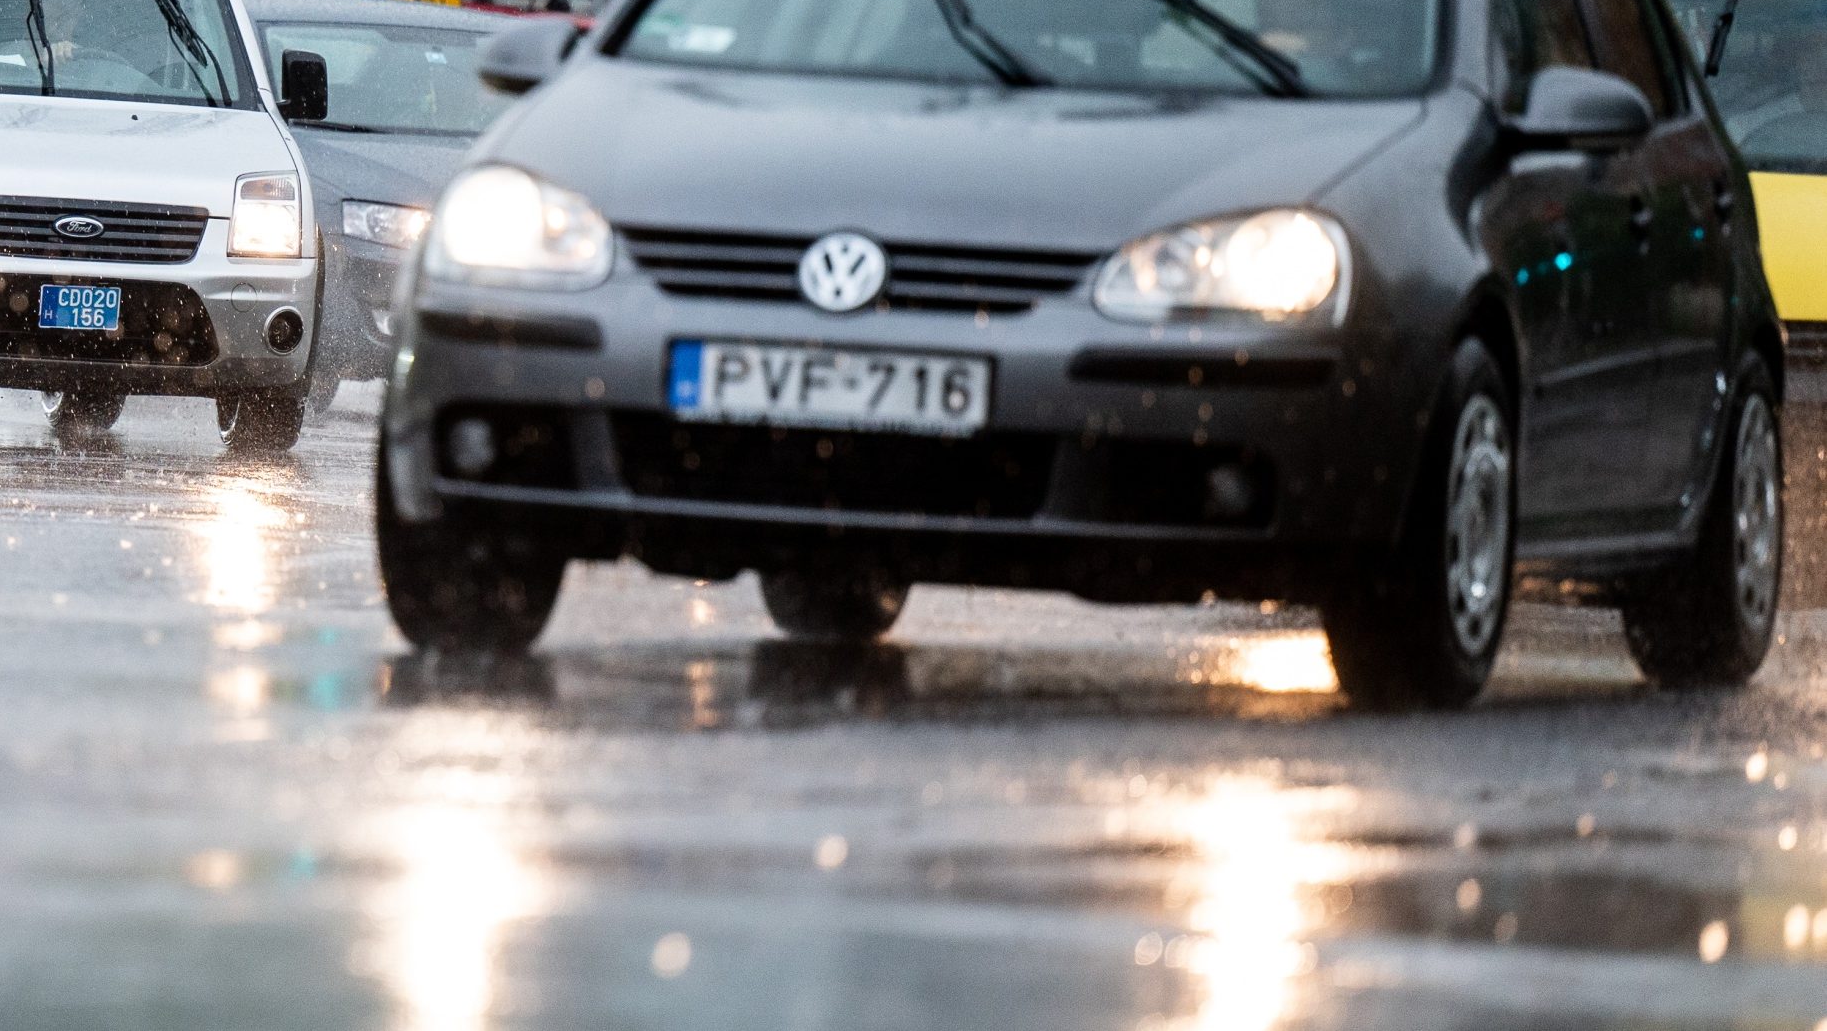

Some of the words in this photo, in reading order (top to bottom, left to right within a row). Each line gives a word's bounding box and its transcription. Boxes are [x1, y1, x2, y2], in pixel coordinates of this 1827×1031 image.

[58, 288, 118, 309] CD020
[72, 308, 105, 327] 156
[713, 349, 971, 416] PVF-716
